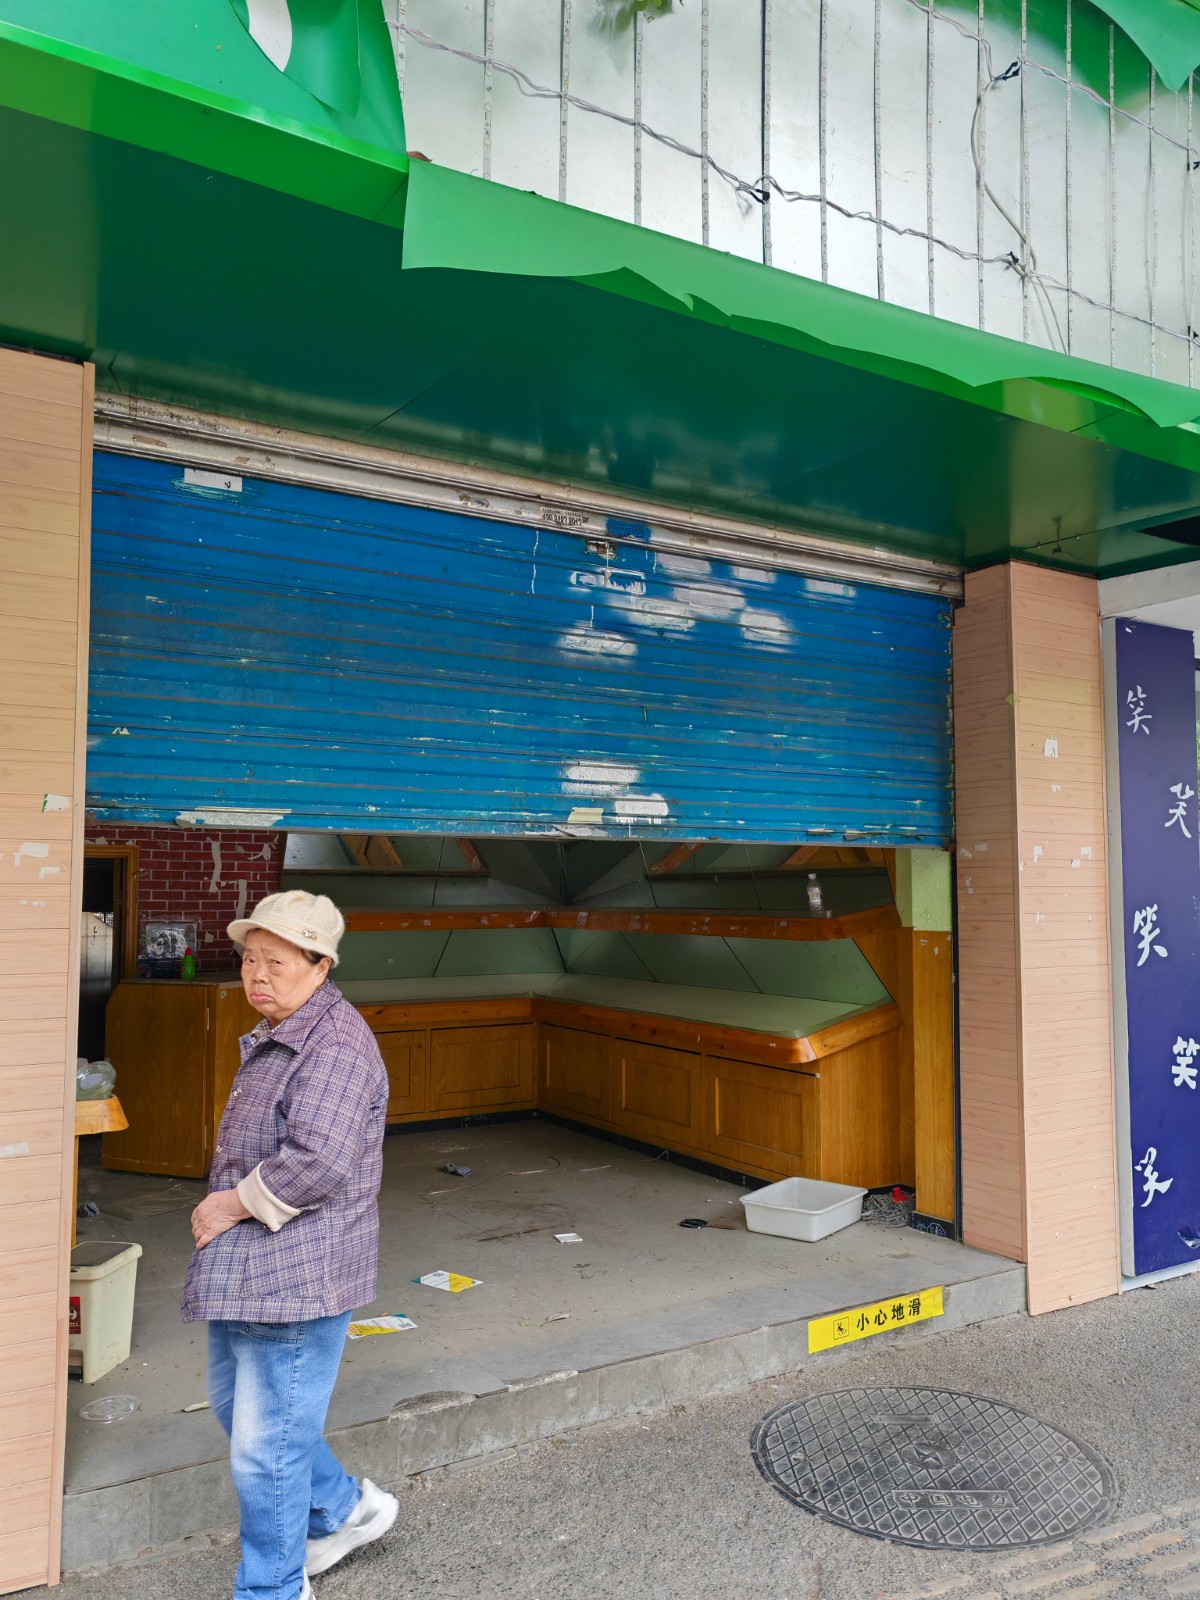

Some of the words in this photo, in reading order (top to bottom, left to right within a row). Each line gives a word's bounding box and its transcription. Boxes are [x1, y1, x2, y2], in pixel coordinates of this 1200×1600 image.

[1172, 1036, 1200, 1089] 笑
[856, 1298, 921, 1332] 小心地滑
[900, 1490, 1006, 1508] 中国电力
